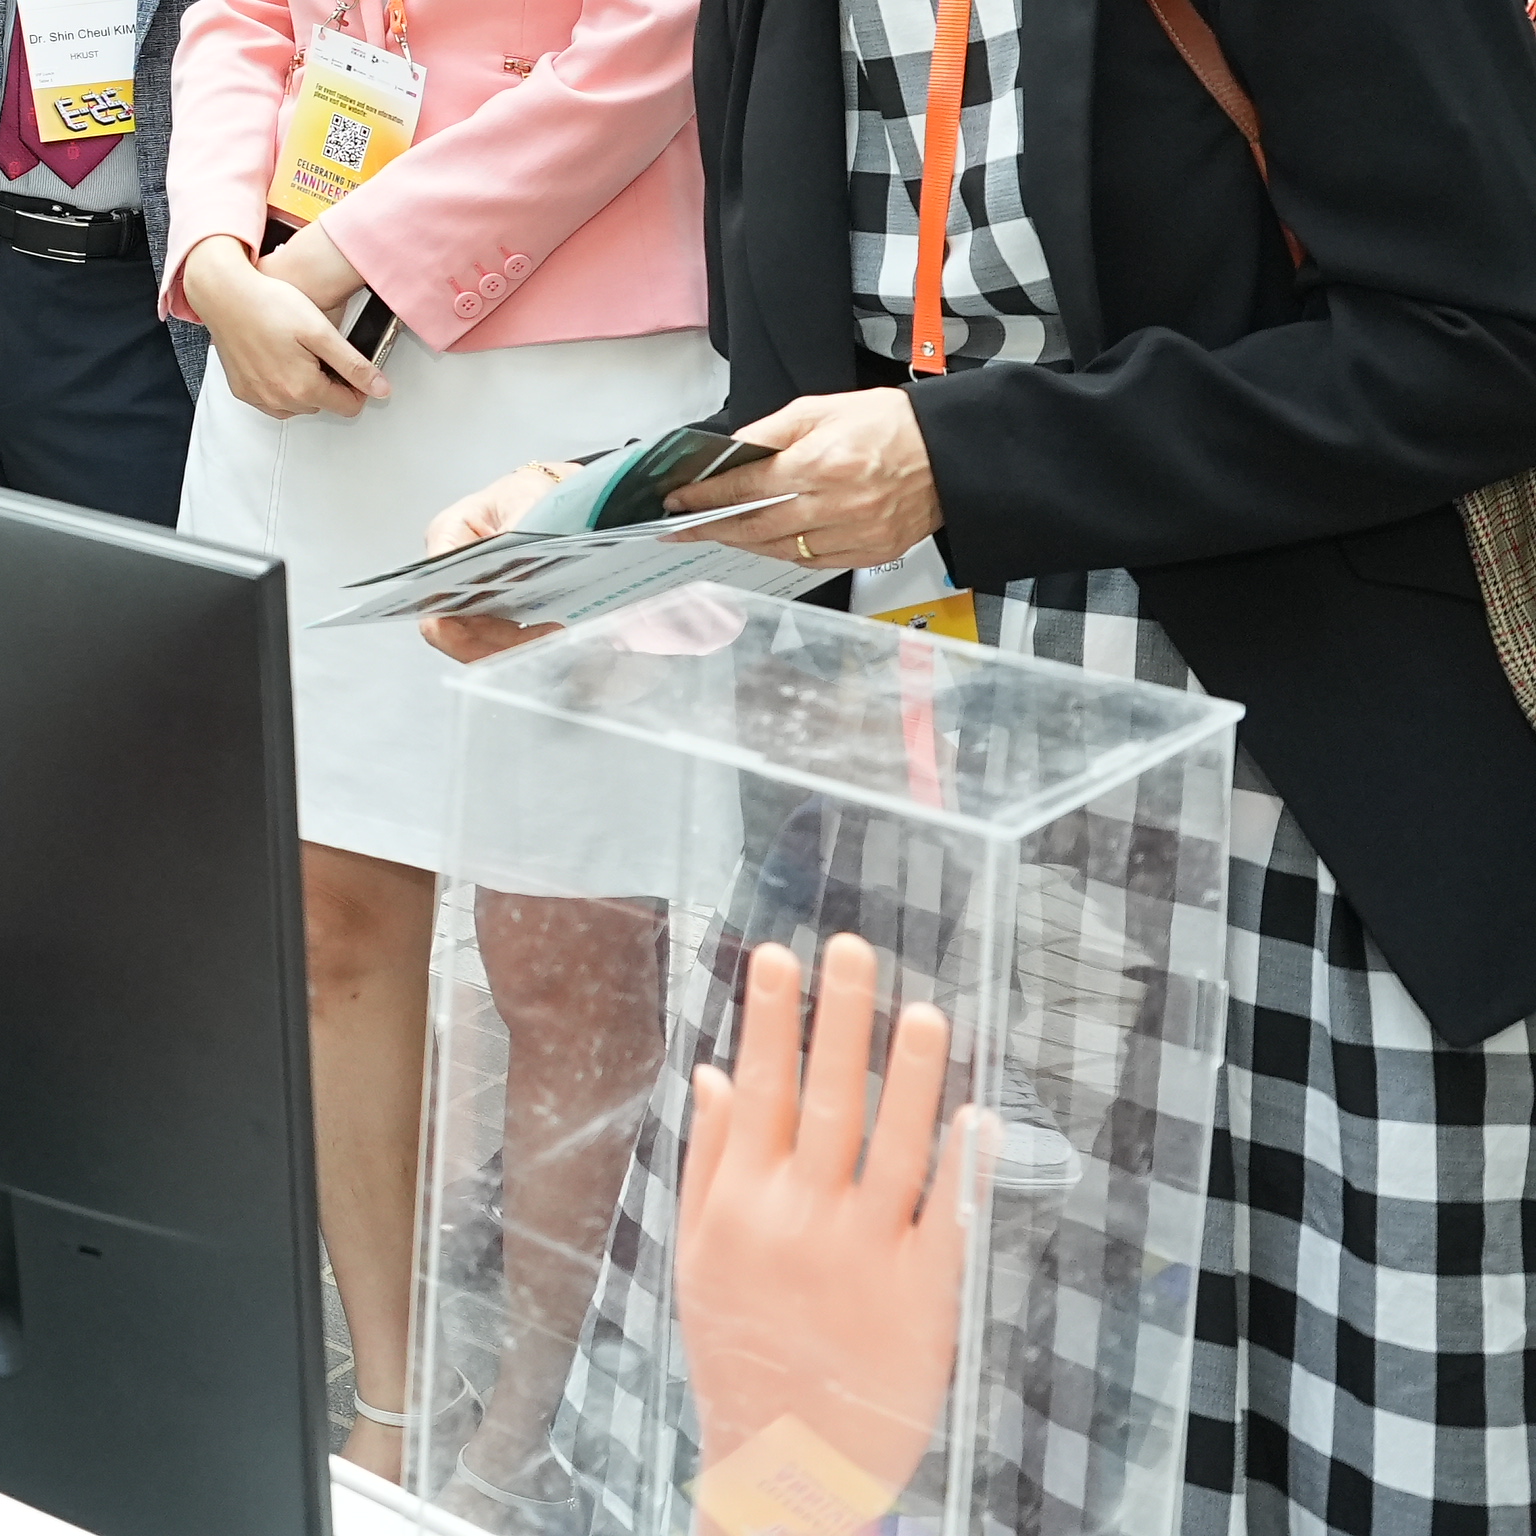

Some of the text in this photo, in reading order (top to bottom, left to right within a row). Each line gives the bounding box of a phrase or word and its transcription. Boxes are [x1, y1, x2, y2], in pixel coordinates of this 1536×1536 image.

[29, 24, 136, 44] Dr. Shin Cheul KIM
[70, 51, 99, 60] HKUST
[297, 158, 345, 185] CELEBRATING
